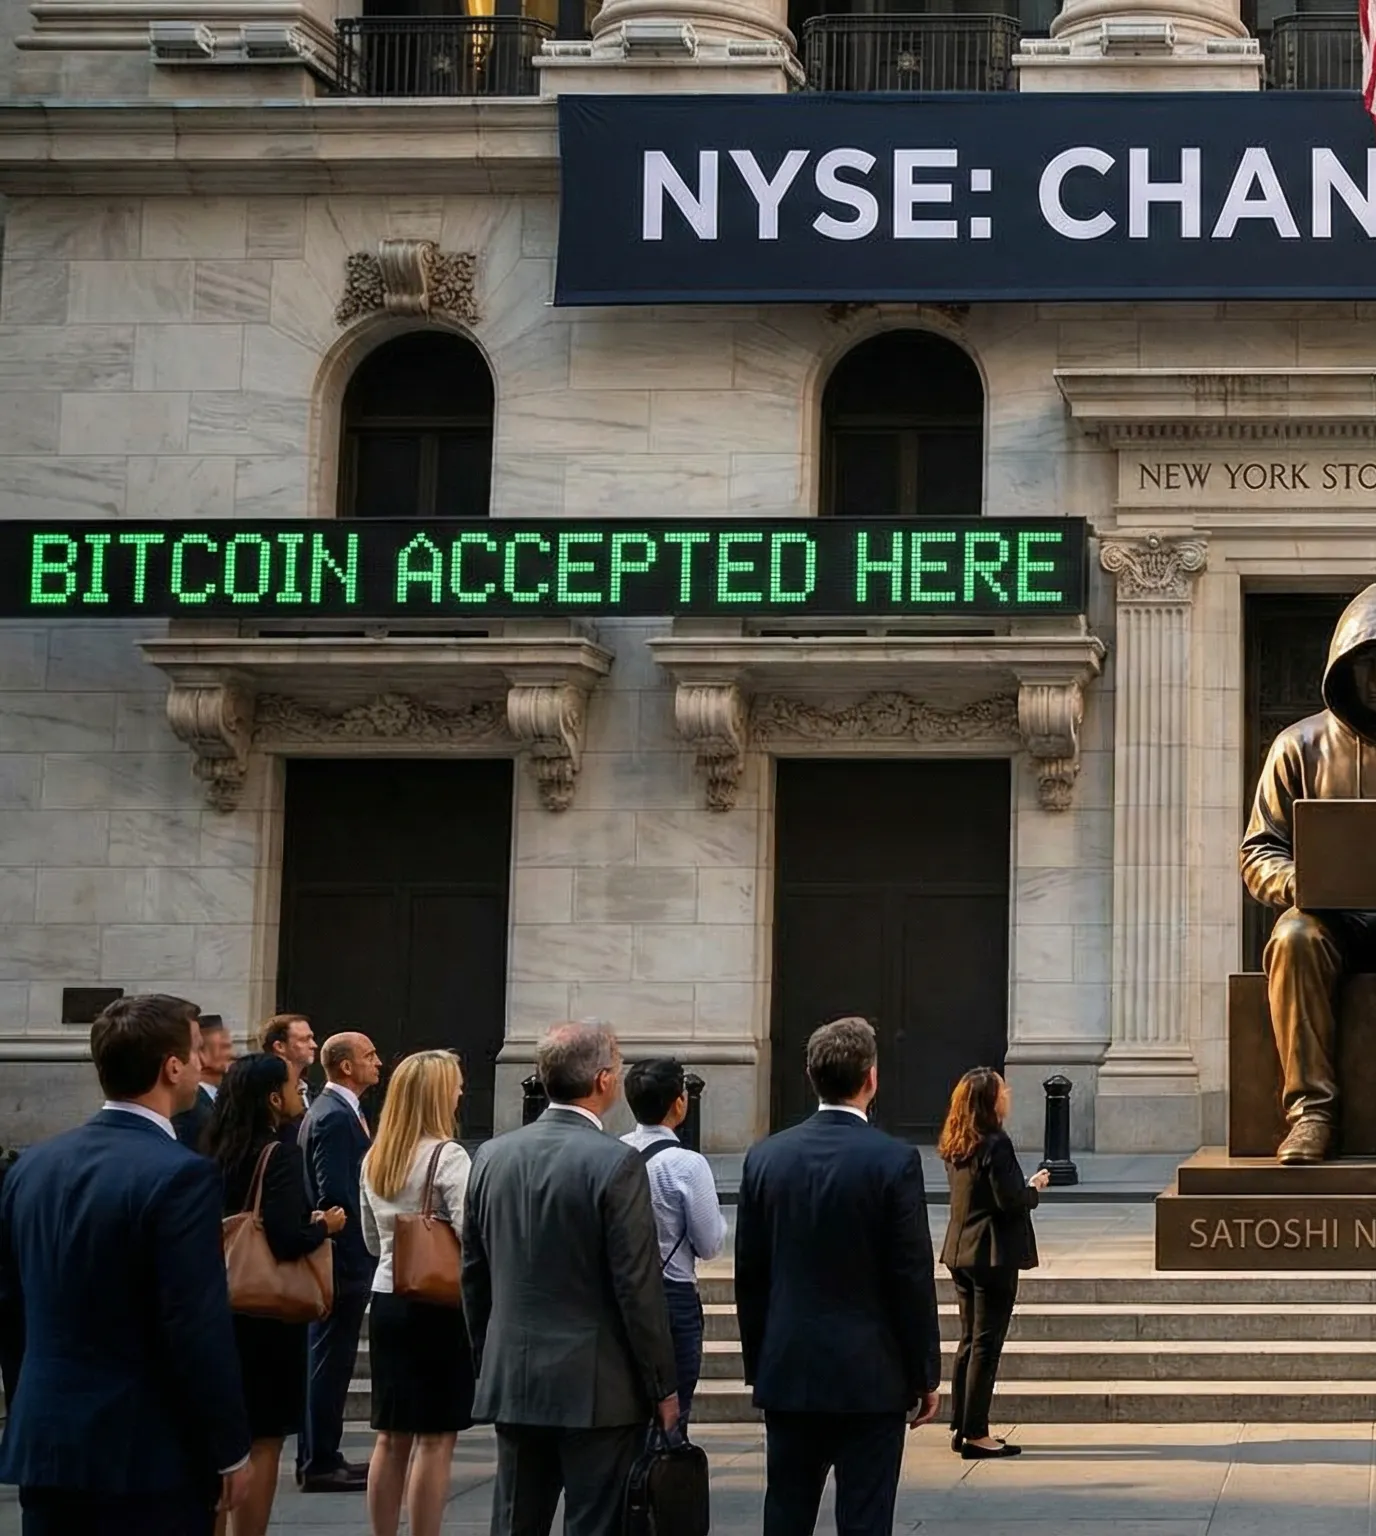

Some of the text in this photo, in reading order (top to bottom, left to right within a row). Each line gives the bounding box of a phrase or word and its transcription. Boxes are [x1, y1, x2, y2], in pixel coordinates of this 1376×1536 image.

[643, 147, 992, 240] NYSE:
[1138, 462, 1212, 490] NEW
[1223, 462, 1310, 490] YORK
[30, 531, 1063, 604] BITCOIN ACCEPTED HERE
[1189, 1218, 1339, 1249] SATOSHI
